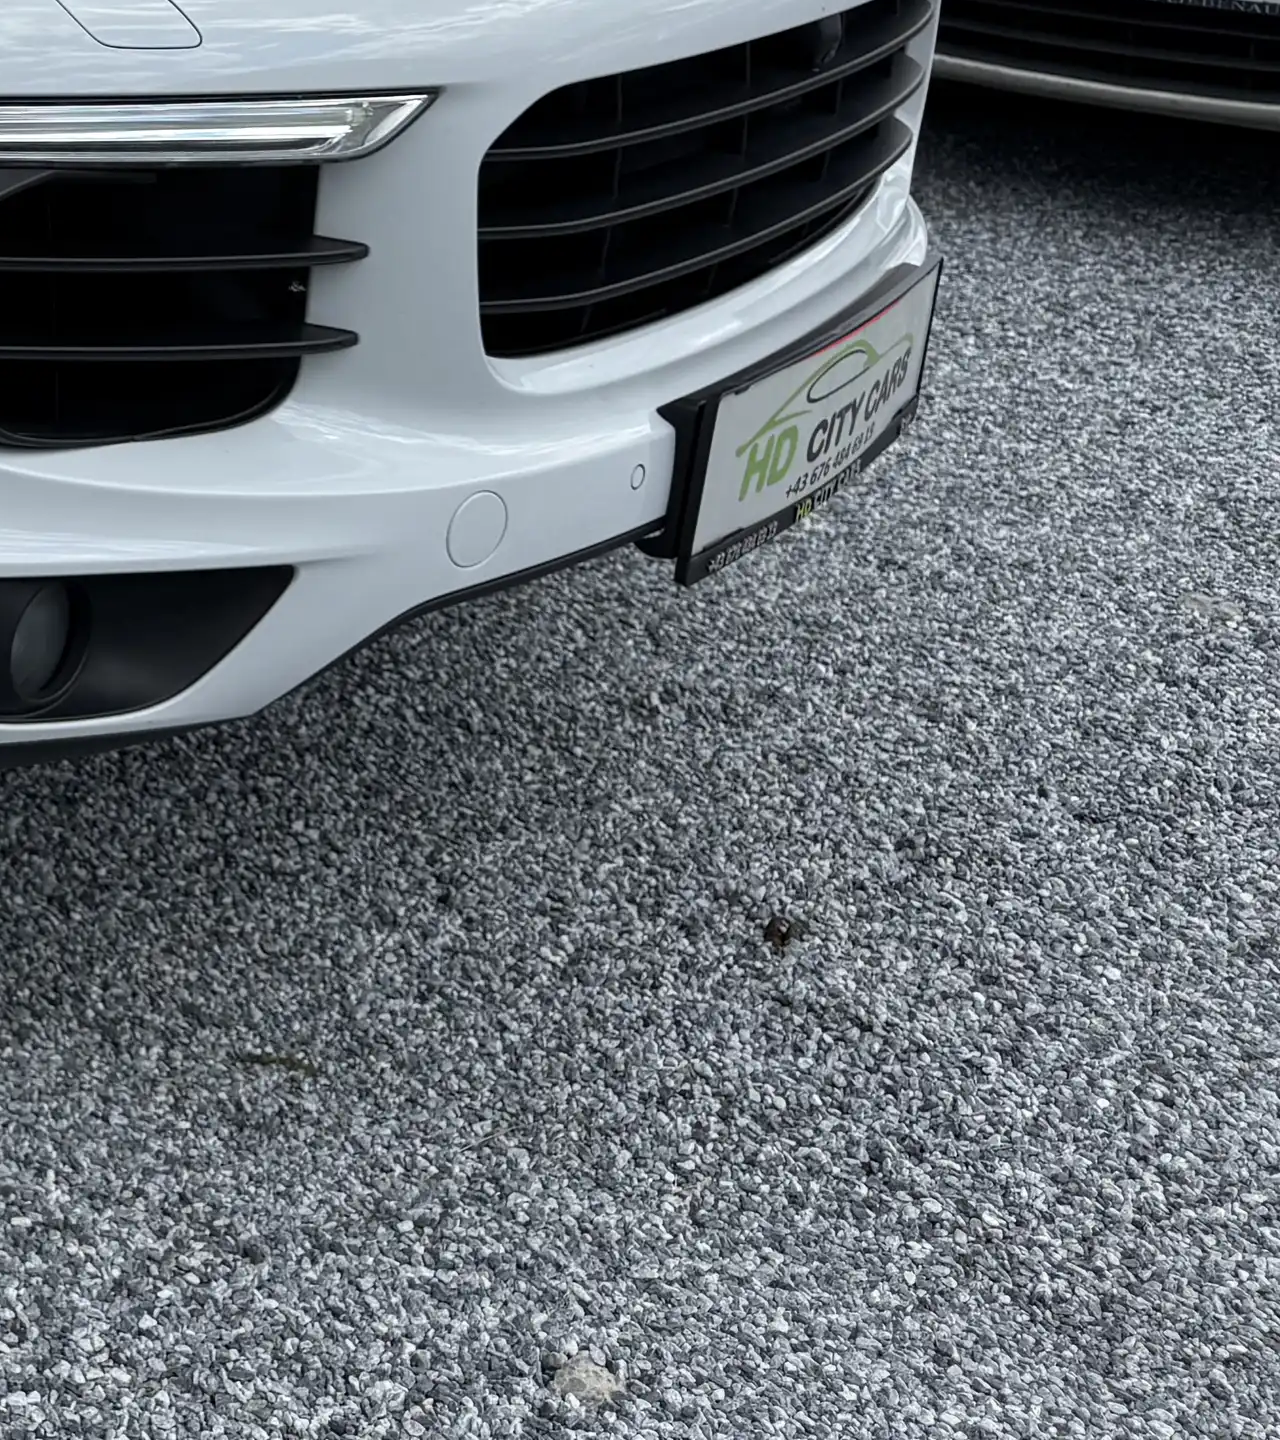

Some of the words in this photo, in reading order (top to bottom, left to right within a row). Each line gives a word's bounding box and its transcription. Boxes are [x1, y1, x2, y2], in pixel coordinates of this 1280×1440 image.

[739, 423, 799, 502] HD
[806, 391, 866, 462] CITY
[864, 346, 912, 421] CARS
[785, 472, 809, 498] +43
[810, 456, 832, 486] 676
